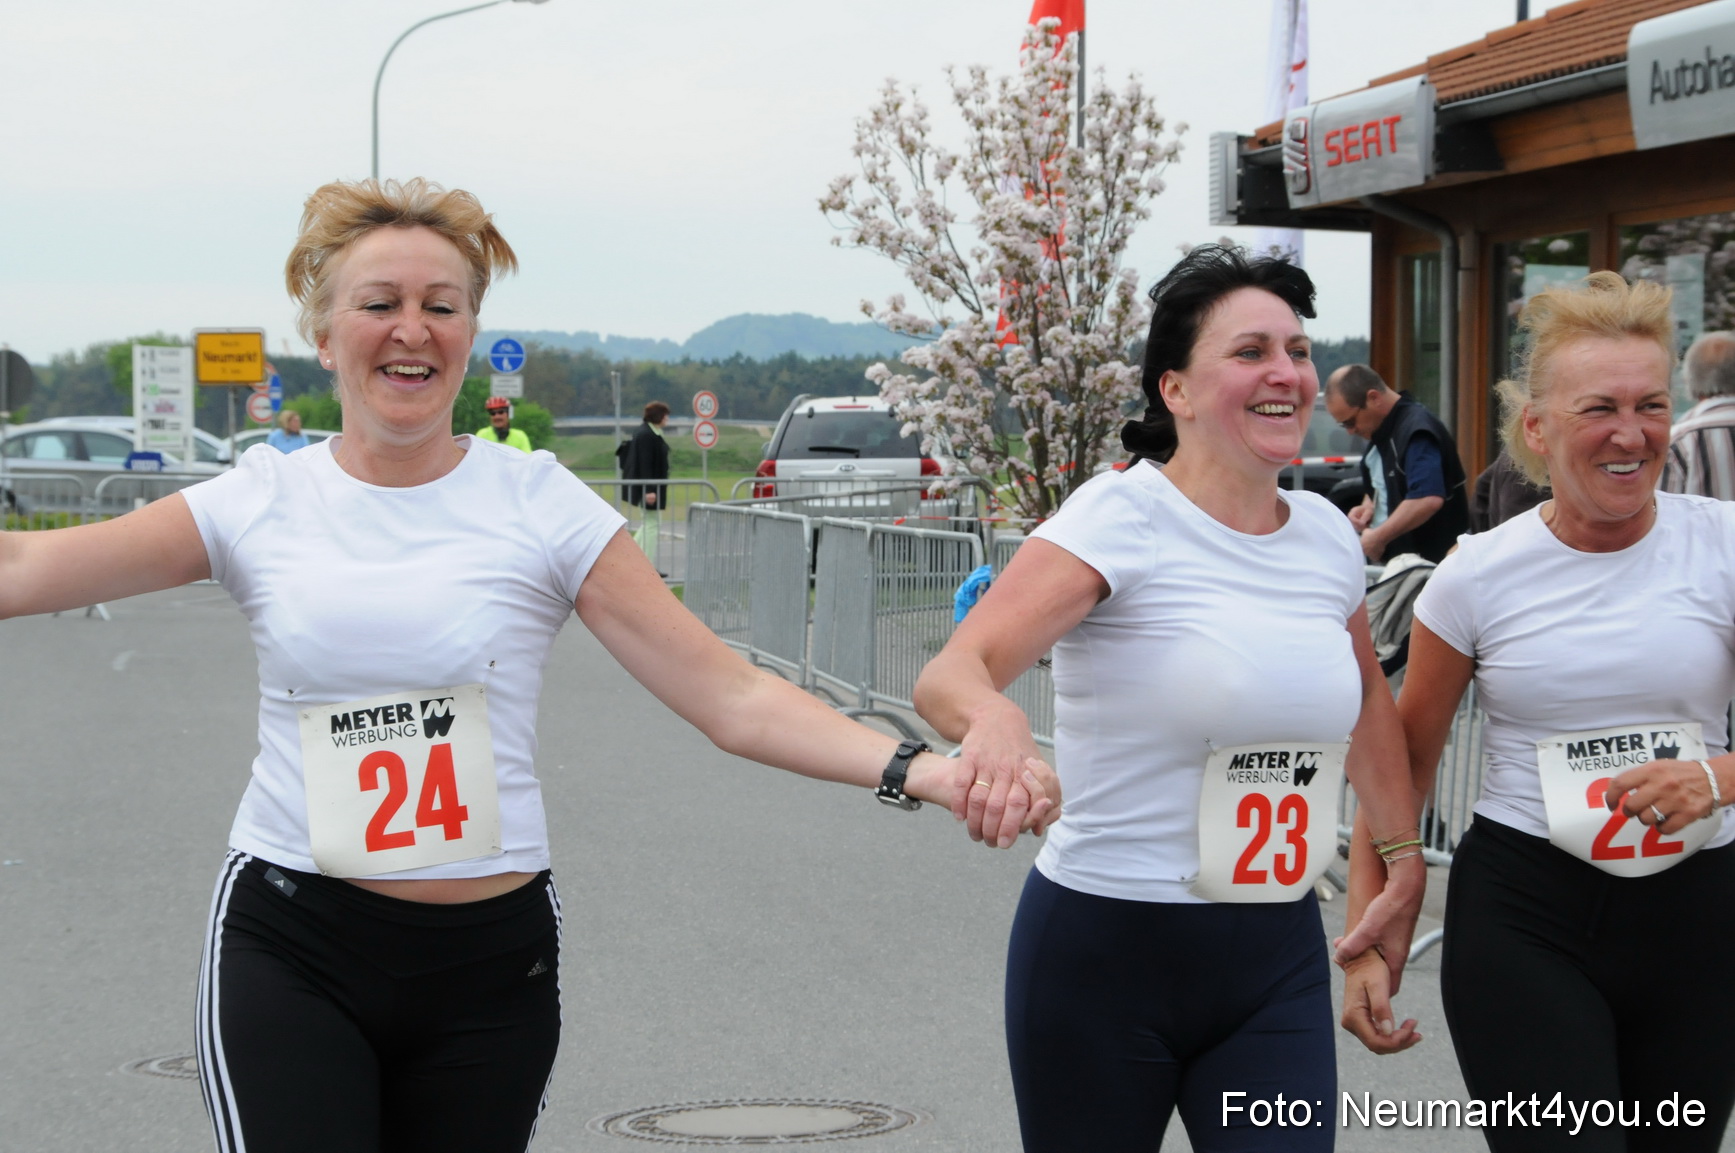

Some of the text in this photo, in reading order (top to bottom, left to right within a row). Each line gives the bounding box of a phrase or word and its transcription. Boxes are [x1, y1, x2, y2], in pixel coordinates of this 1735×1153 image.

[1324, 114, 1402, 167] SEAT
[202, 350, 258, 363] Neumarkt
[700, 399, 713, 411] 60
[330, 702, 415, 735] MEYER
[331, 722, 418, 749] WERBUNG
[1566, 733, 1647, 760] MEYER
[1228, 751, 1291, 770] MEYER
[1567, 751, 1649, 773] WERBUNG
[1226, 770, 1290, 784] WERBUNG
[358, 742, 469, 853] 24
[1231, 792, 1309, 886] 23
